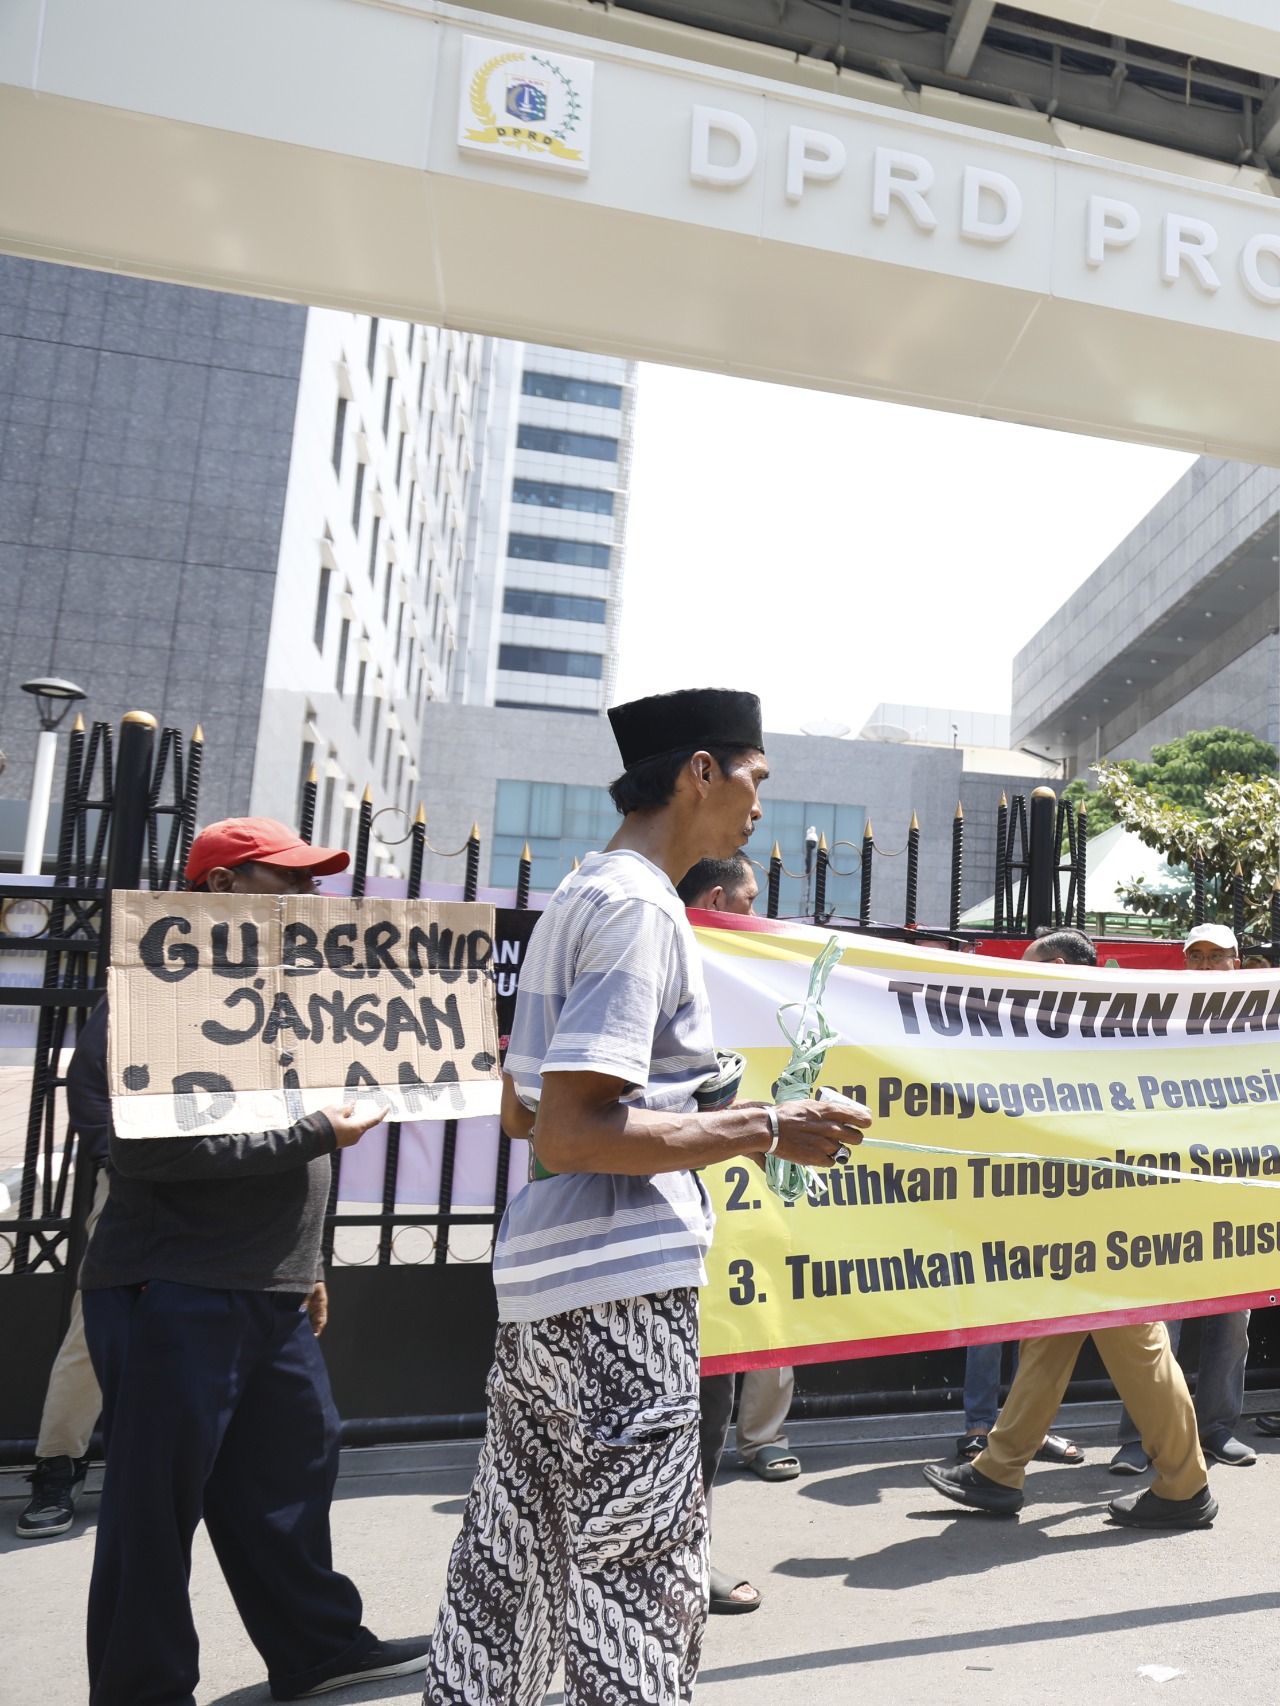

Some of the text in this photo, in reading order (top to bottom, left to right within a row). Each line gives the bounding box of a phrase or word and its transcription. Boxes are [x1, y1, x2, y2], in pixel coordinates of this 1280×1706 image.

[496, 127, 553, 146] DPRD
[690, 104, 1022, 243] DPRD
[139, 915, 497, 990] GUBERNUR
[201, 977, 466, 1052] JANGAN
[888, 980, 1178, 1039] TUNTUTAN
[878, 1076, 1104, 1119] Penyegelan
[1109, 1081, 1137, 1111] &
[724, 1166, 762, 1211] 2.
[783, 1162, 957, 1208] utihkan
[967, 1149, 1182, 1199] Tunggakan
[728, 1258, 767, 1306] 3.
[785, 1248, 975, 1300] Turunkan
[981, 1239, 1096, 1283] Harga
[1106, 1229, 1203, 1271] Sewa
